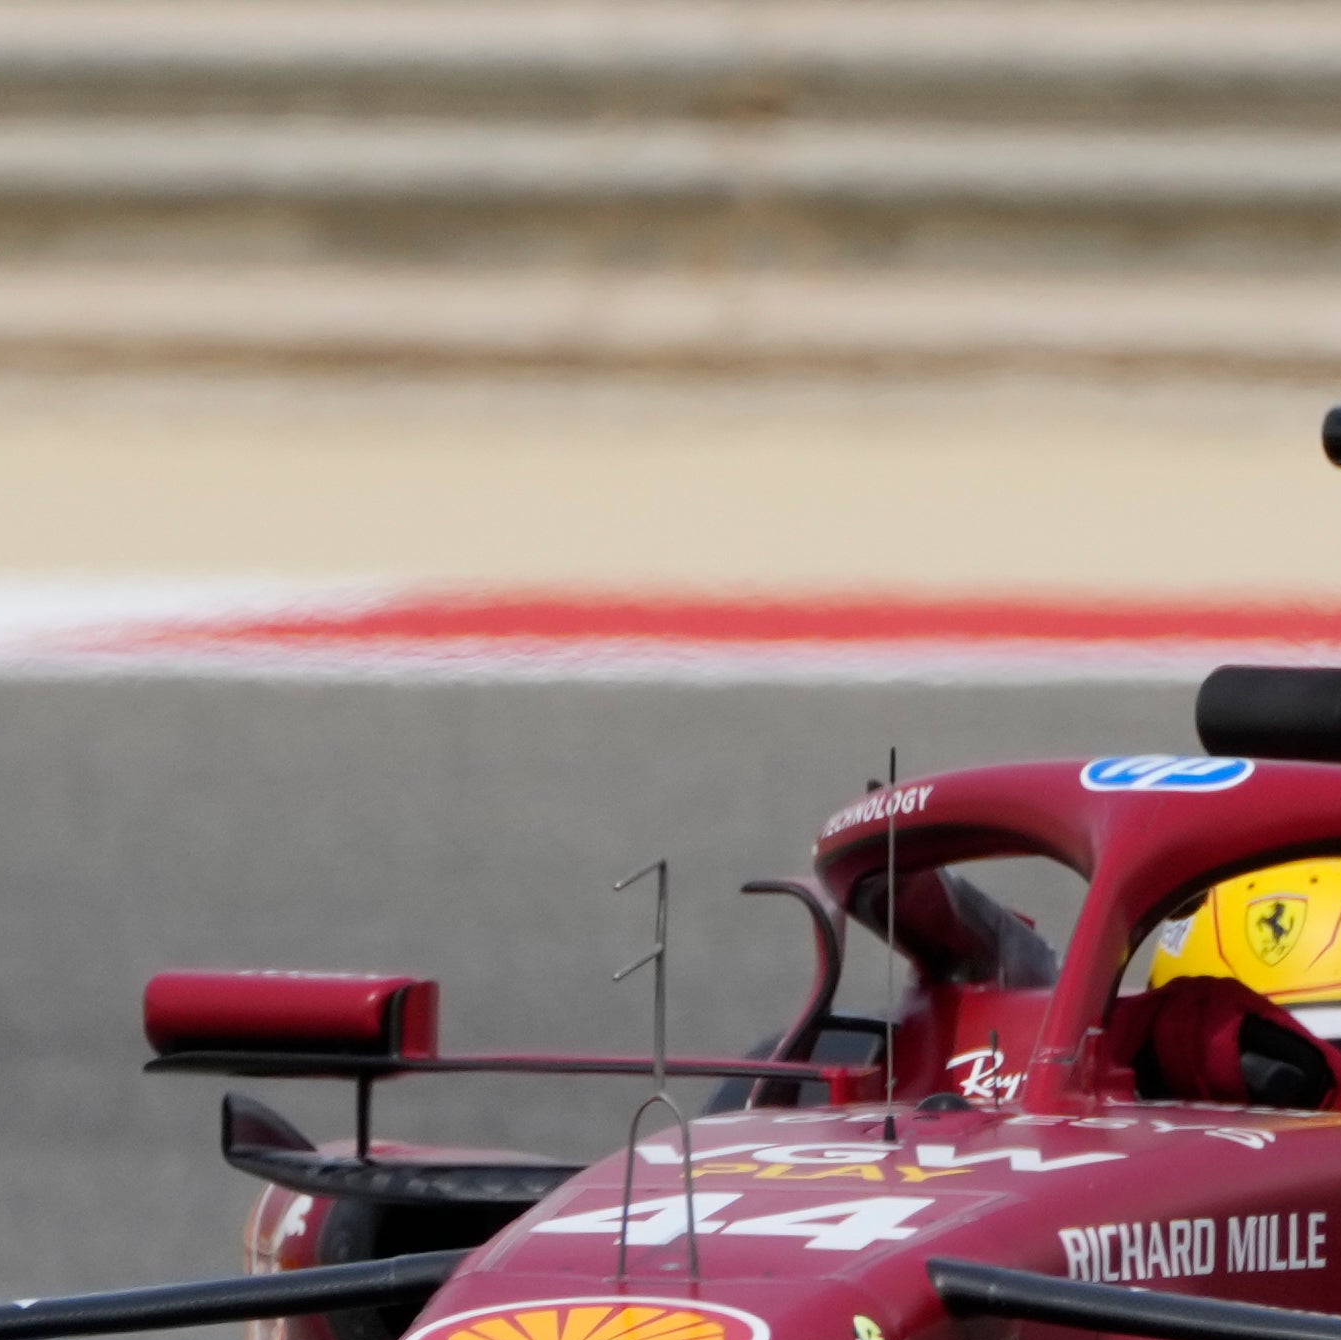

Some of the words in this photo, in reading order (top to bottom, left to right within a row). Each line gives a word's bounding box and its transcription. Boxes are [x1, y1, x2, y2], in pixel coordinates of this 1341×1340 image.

[635, 1142, 1129, 1173] VGW
[680, 1163, 976, 1183] PLAY
[530, 1192, 935, 1250] 44
[1059, 1217, 1216, 1283] RICHARD
[1226, 1211, 1328, 1274] MILLE
